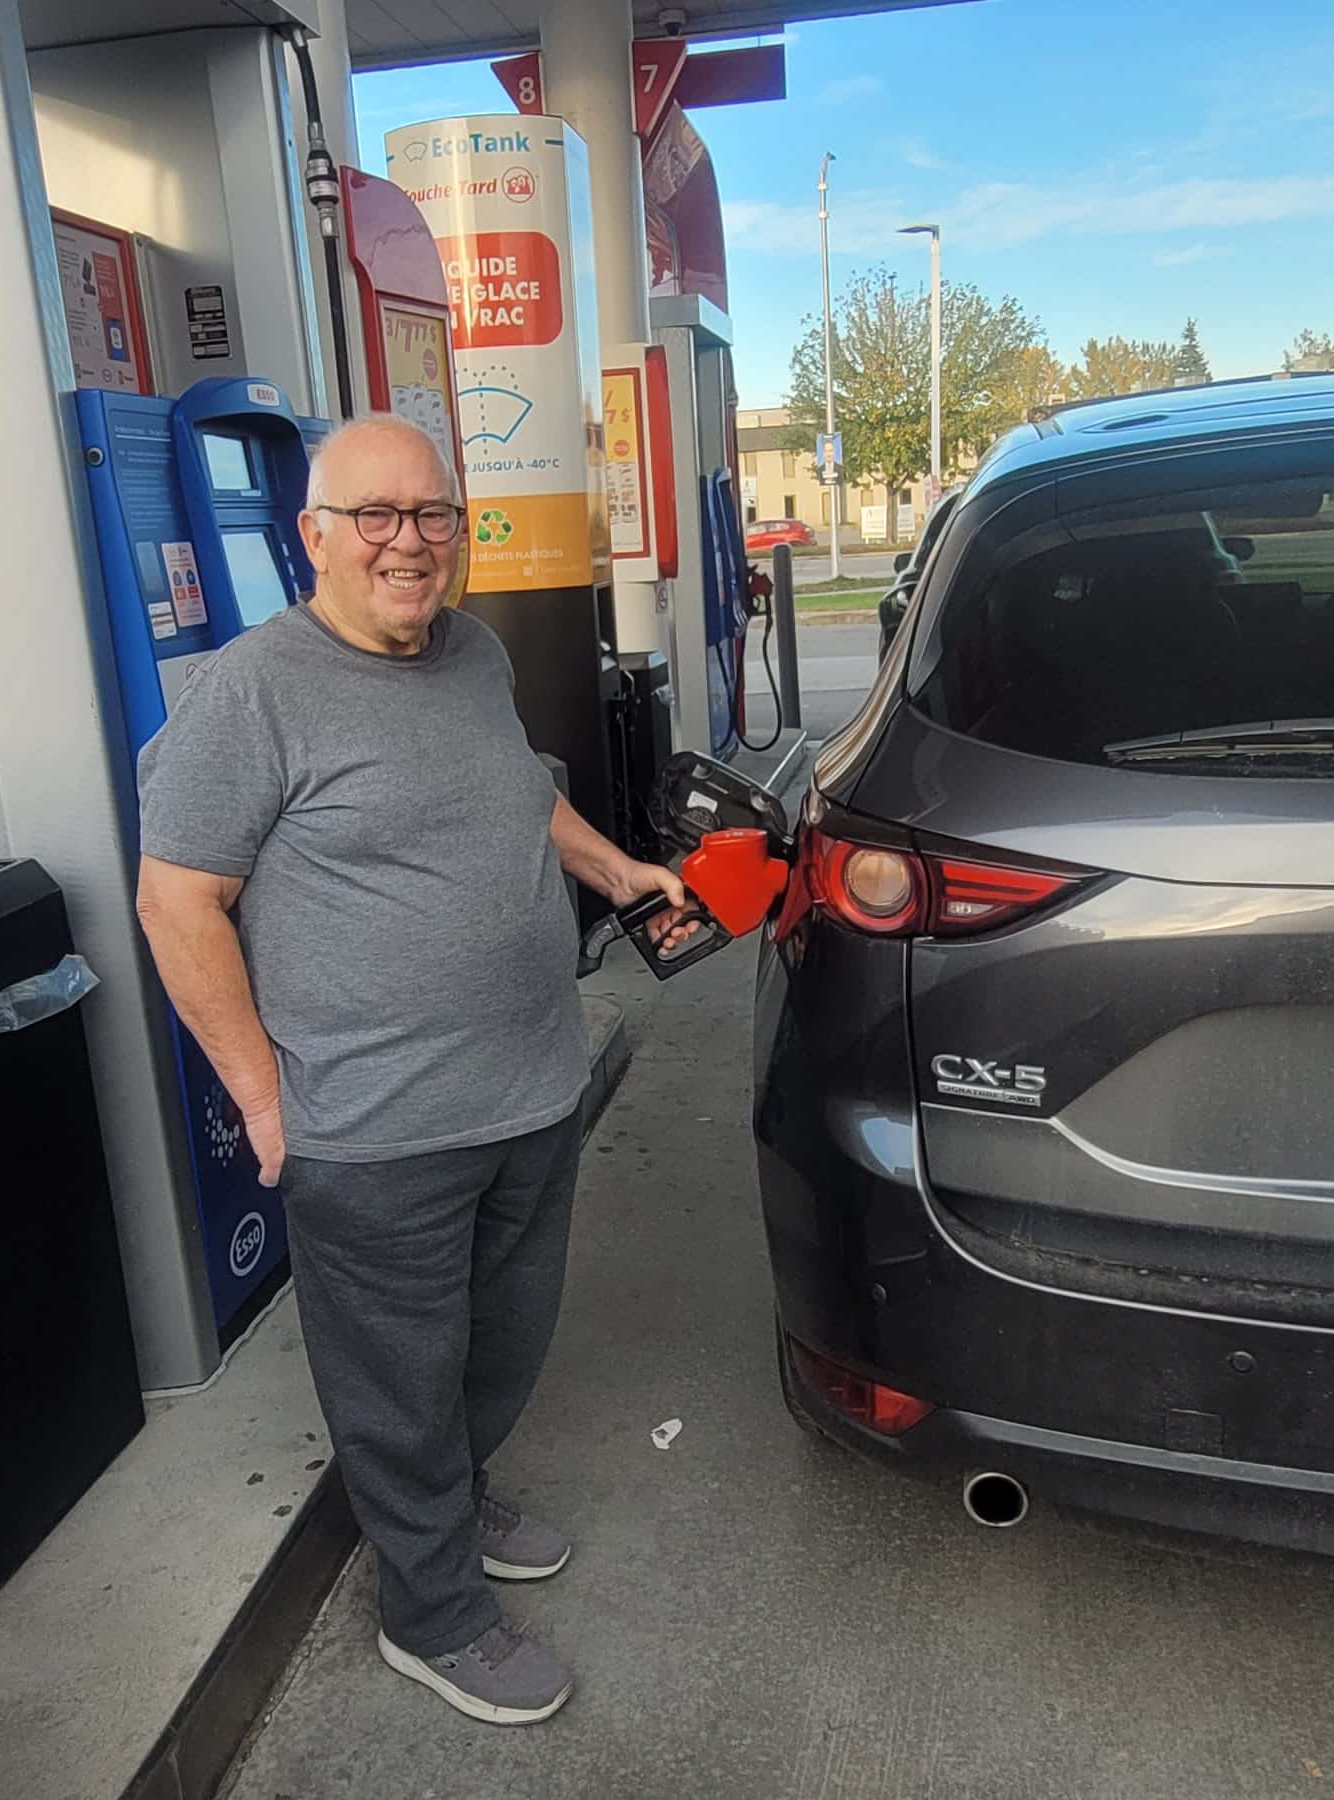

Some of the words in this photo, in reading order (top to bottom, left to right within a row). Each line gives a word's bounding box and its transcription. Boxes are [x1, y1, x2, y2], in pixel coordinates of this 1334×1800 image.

[519, 76, 536, 105] 8
[640, 64, 659, 93] 7
[431, 131, 530, 158] EcoTank
[472, 459, 524, 473] JUSQU'À
[931, 1053, 1047, 1092] CX-5
[235, 1224, 261, 1263] Esso
